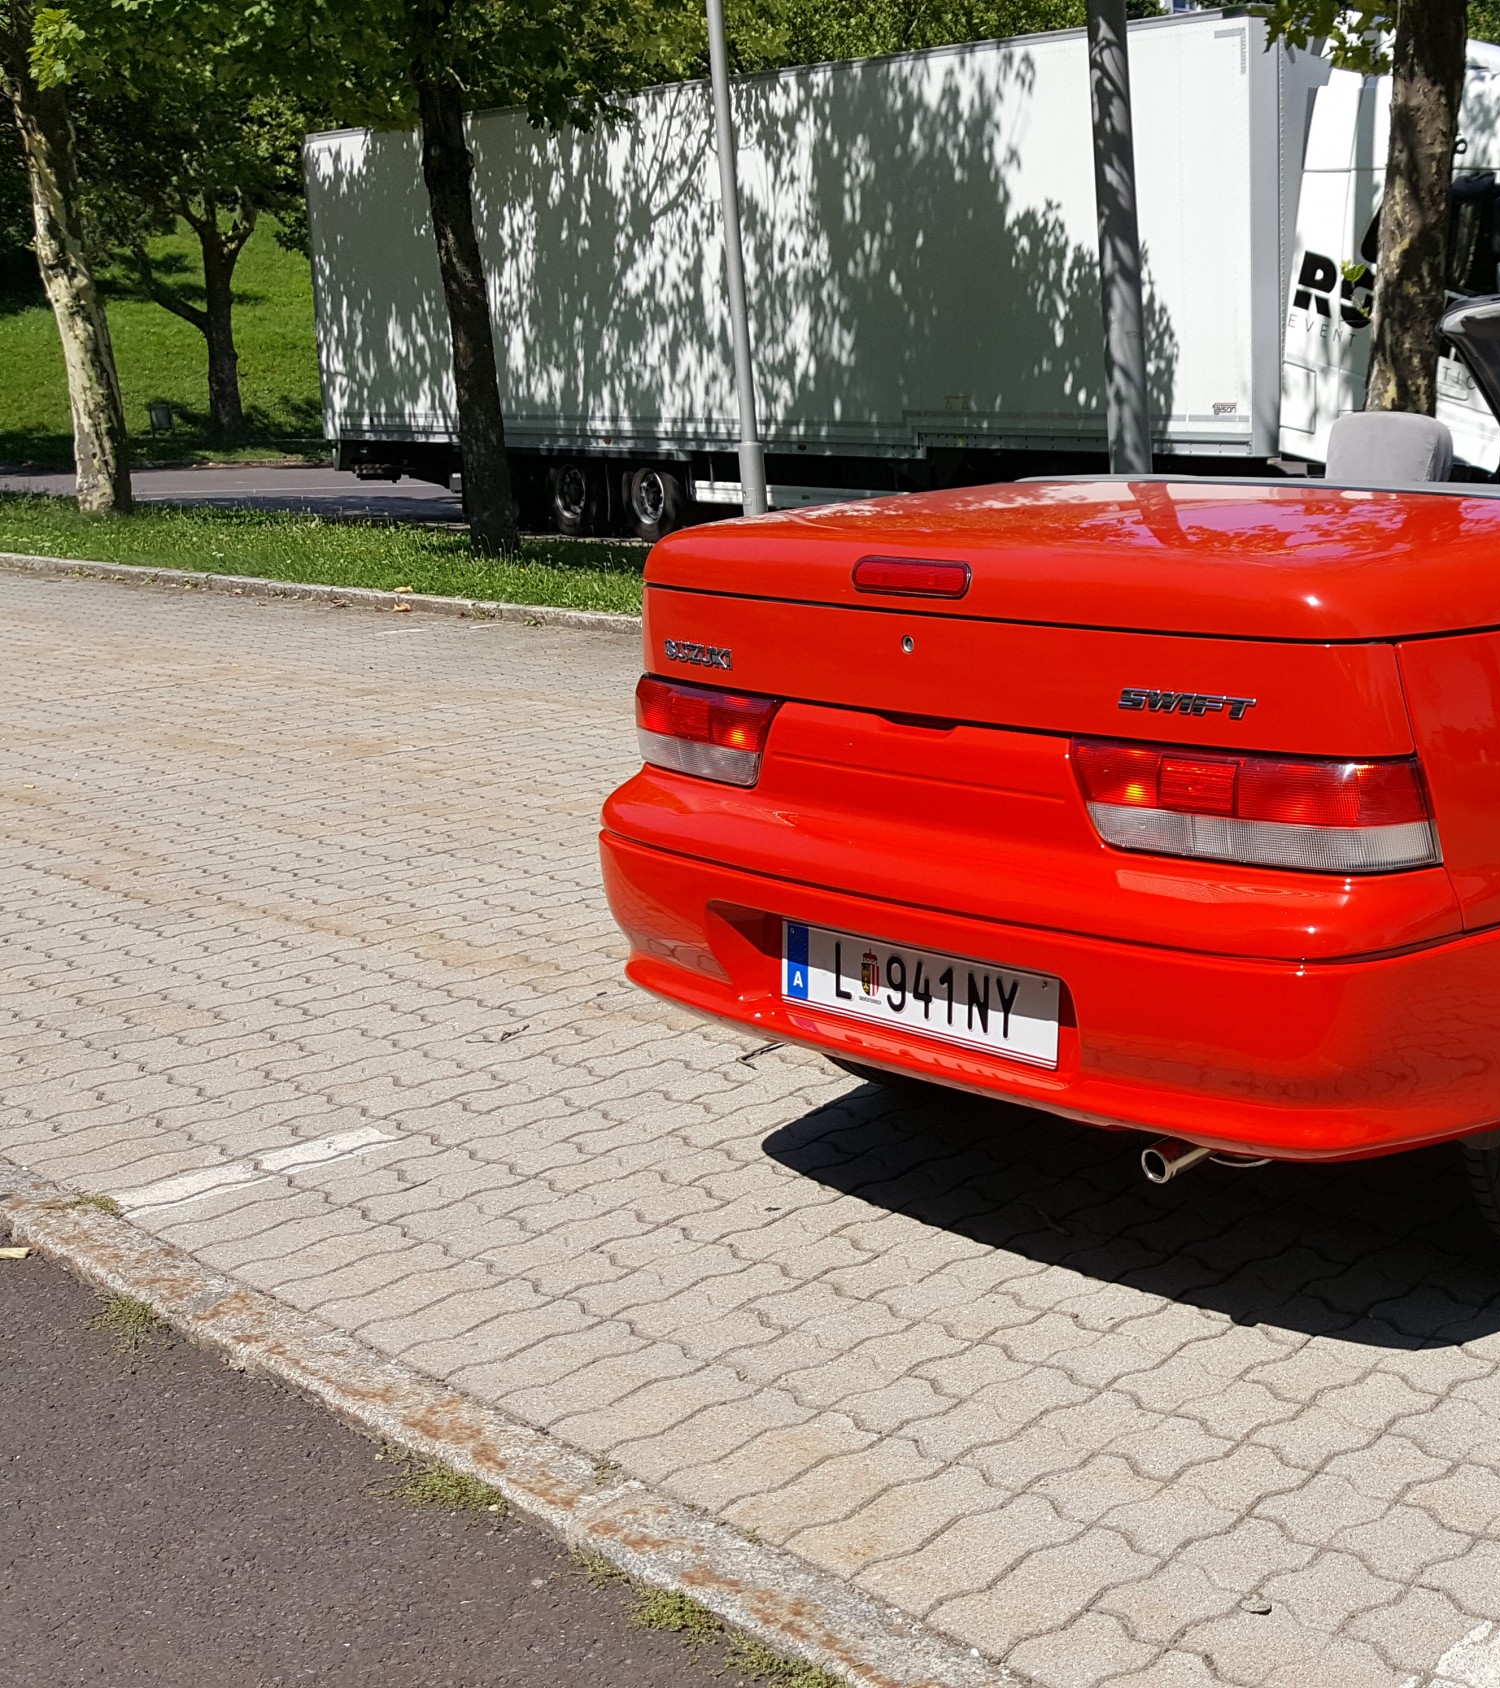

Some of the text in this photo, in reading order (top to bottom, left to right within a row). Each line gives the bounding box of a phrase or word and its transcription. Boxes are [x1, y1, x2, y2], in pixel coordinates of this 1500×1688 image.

[1287, 313, 1357, 348] EVENT
[664, 638, 733, 671] SUZUKI
[1118, 687, 1257, 719] SWIFT
[792, 969, 804, 989] A
